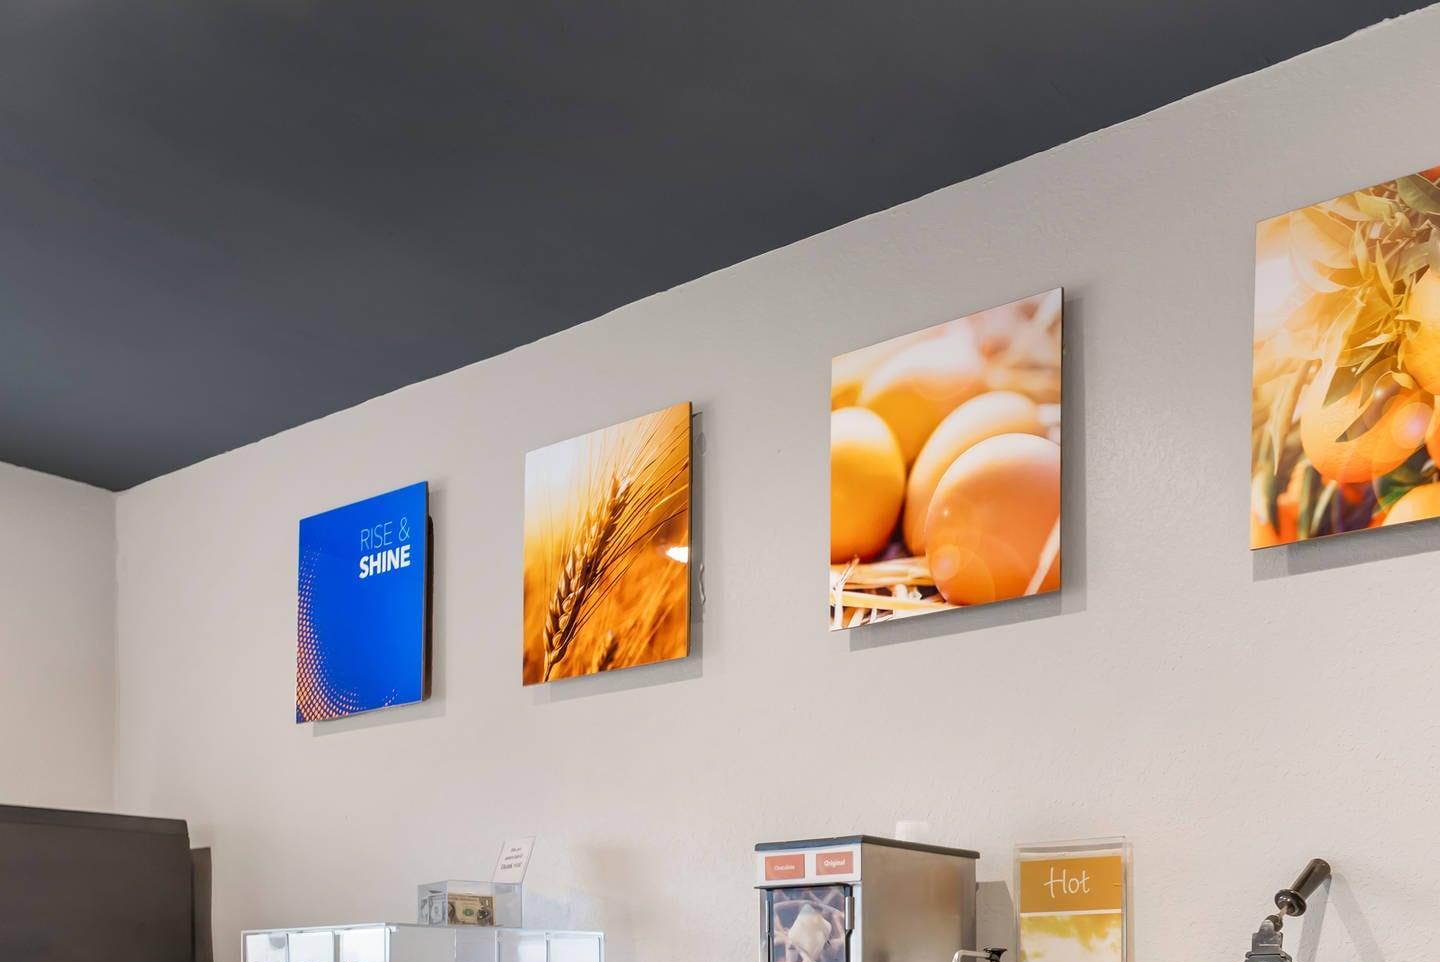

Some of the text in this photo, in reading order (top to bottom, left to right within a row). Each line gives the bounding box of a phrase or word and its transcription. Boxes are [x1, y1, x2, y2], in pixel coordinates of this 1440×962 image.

[360, 516, 411, 552] RISE &
[359, 544, 411, 579] SHINE
[1043, 867, 1090, 899] Hot
